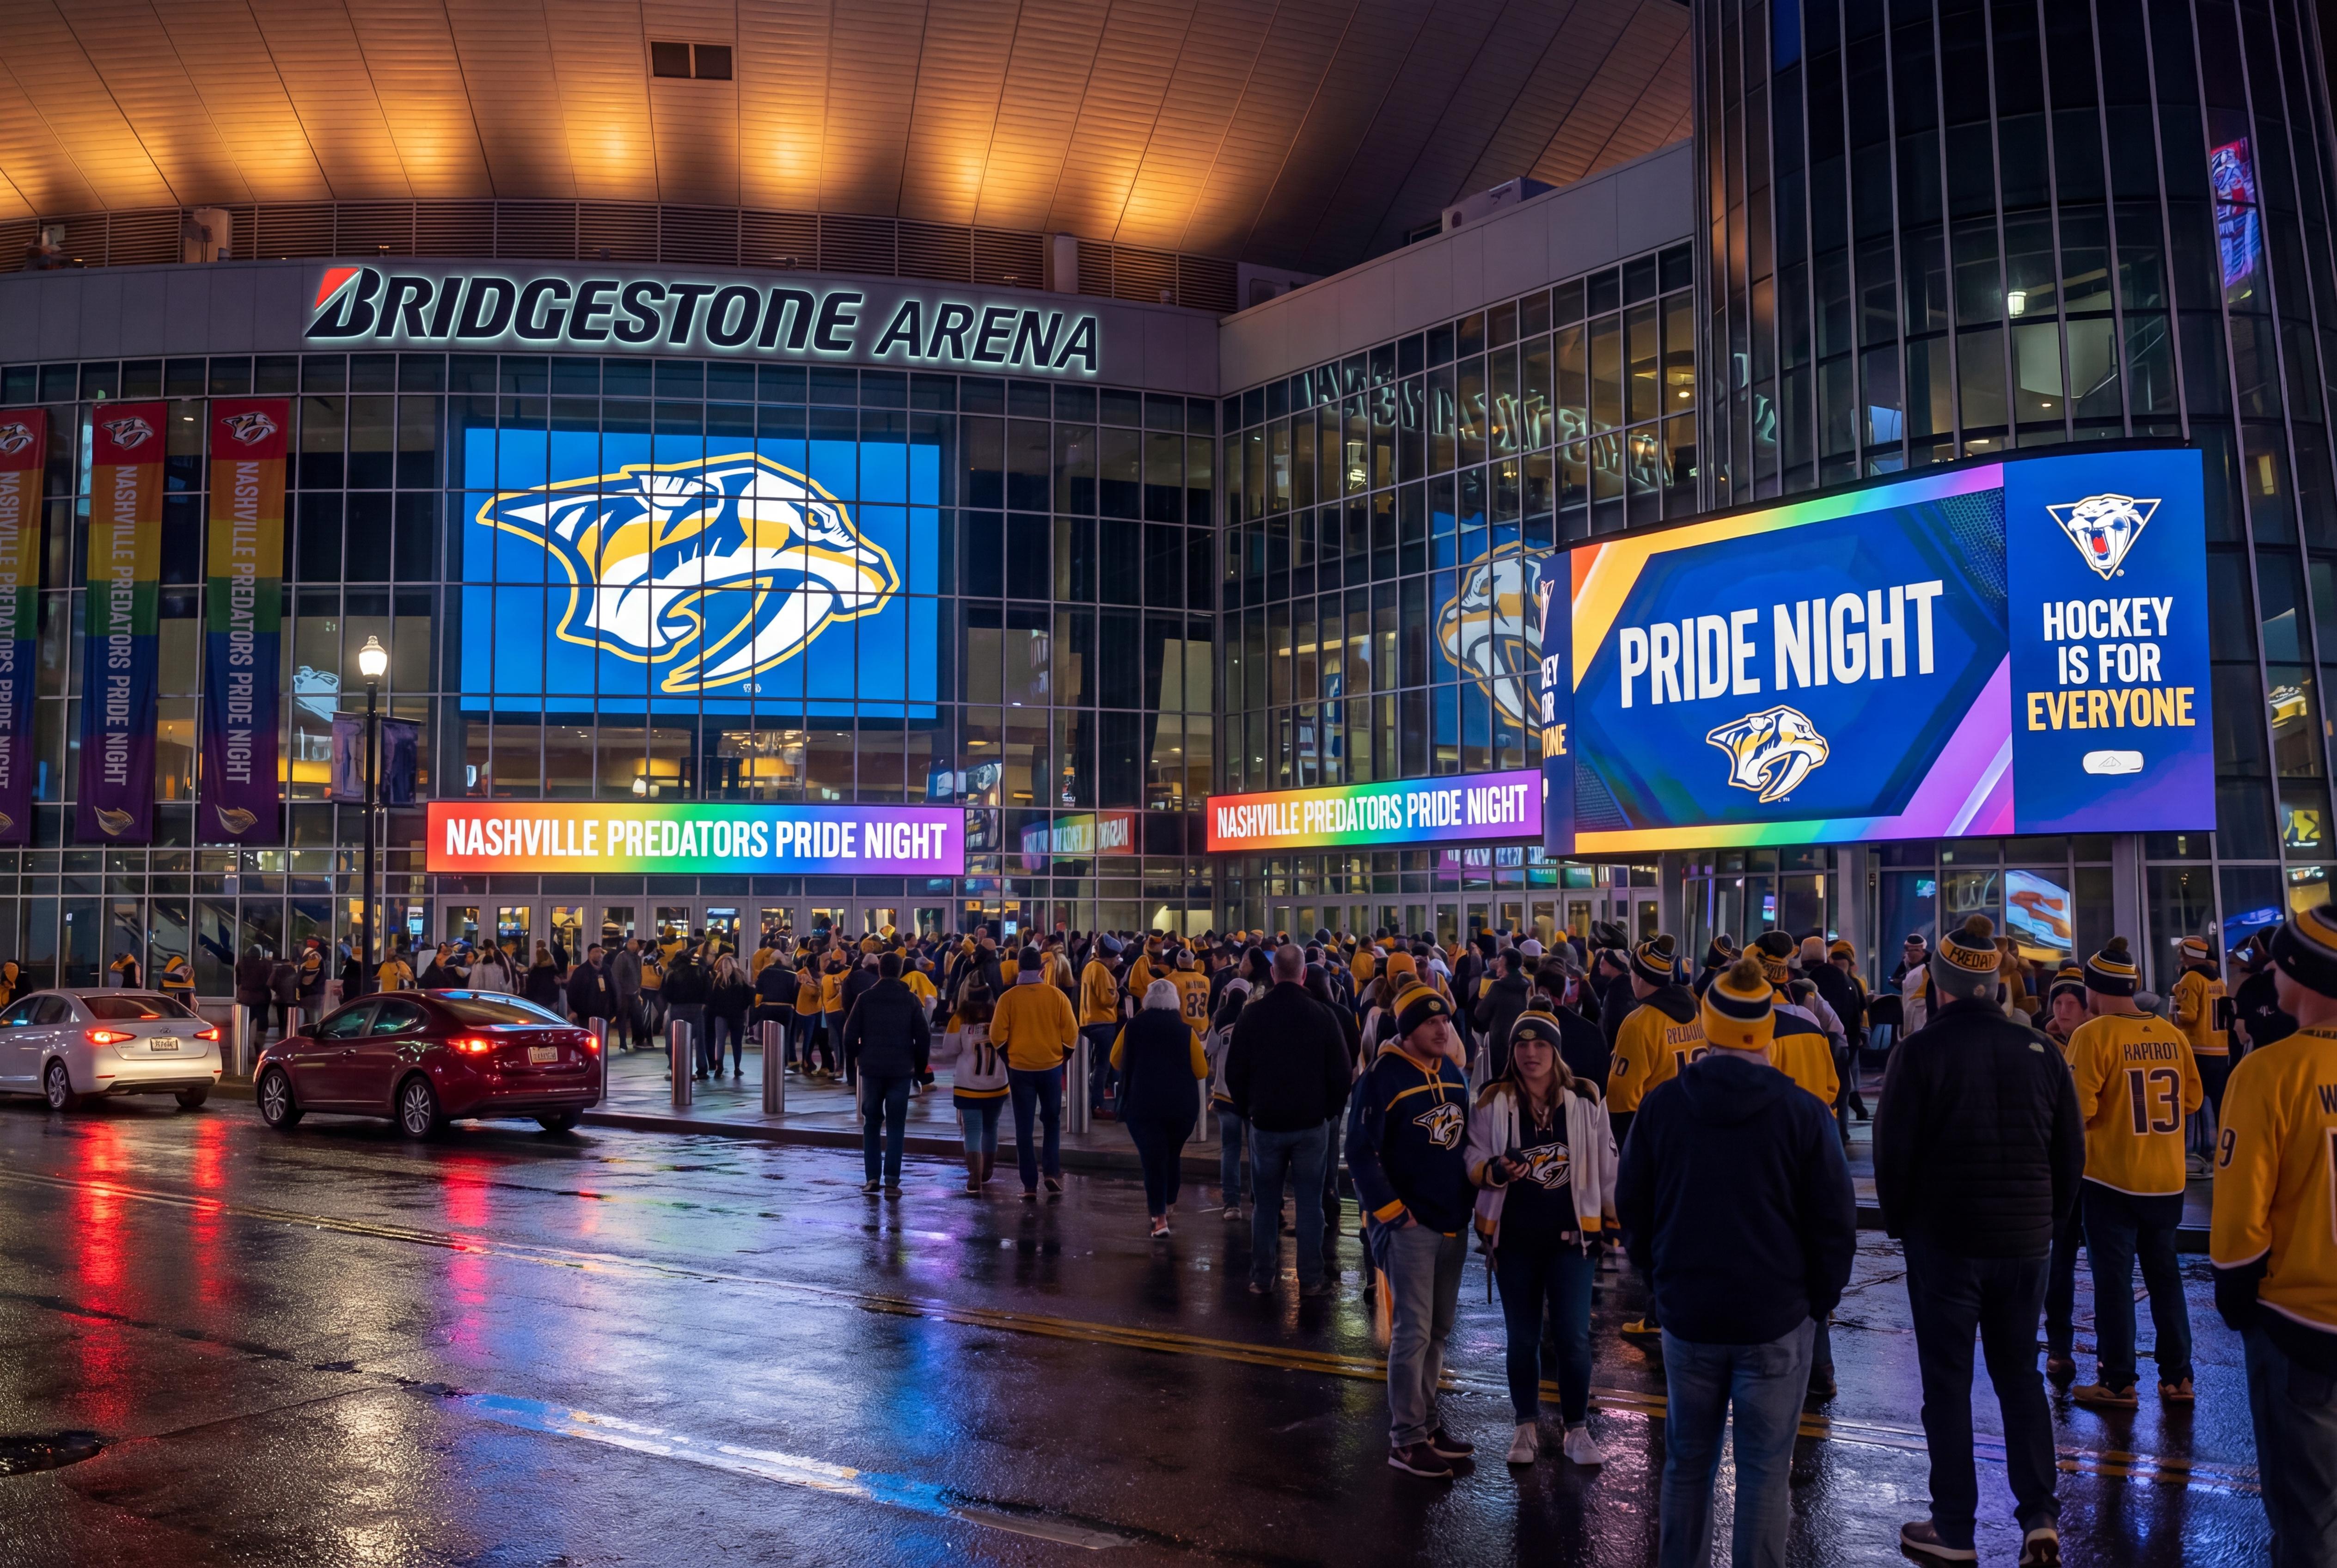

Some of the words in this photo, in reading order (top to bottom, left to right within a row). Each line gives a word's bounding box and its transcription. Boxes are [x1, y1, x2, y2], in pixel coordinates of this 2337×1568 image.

[304, 266, 863, 352] BRIDGESTONE
[874, 300, 1097, 372] ARENA
[0, 472, 20, 565] NASHVILLE
[112, 466, 138, 560] NASHVILLE
[232, 461, 259, 557] NASHVILLE
[108, 566, 134, 669] PREDATORS
[229, 563, 256, 666] PREDATORS
[2043, 597, 2173, 641] HOCKEY
[1620, 608, 1760, 709] PRIDE
[1774, 580, 1943, 691] NIGHT
[2058, 645, 2089, 685] IS
[2098, 643, 2161, 683] FOR
[106, 675, 131, 726] PRIDE
[228, 673, 253, 724] PRIDE
[2027, 687, 2196, 731] EVERYONE
[104, 733, 128, 786] NIGHT
[226, 729, 252, 784] NIGHT
[447, 819, 599, 856] NASHVILLE
[607, 820, 768, 858] PREDATORS
[776, 821, 857, 858] PRIDE
[864, 822, 947, 859] NIGHT
[1217, 802, 1299, 839] NASHVILLE
[1304, 794, 1402, 834] PREDATORS
[1407, 789, 1462, 828] PRIDE
[1467, 784, 1528, 825] NIGHT
[2123, 1067, 2180, 1135] 13
